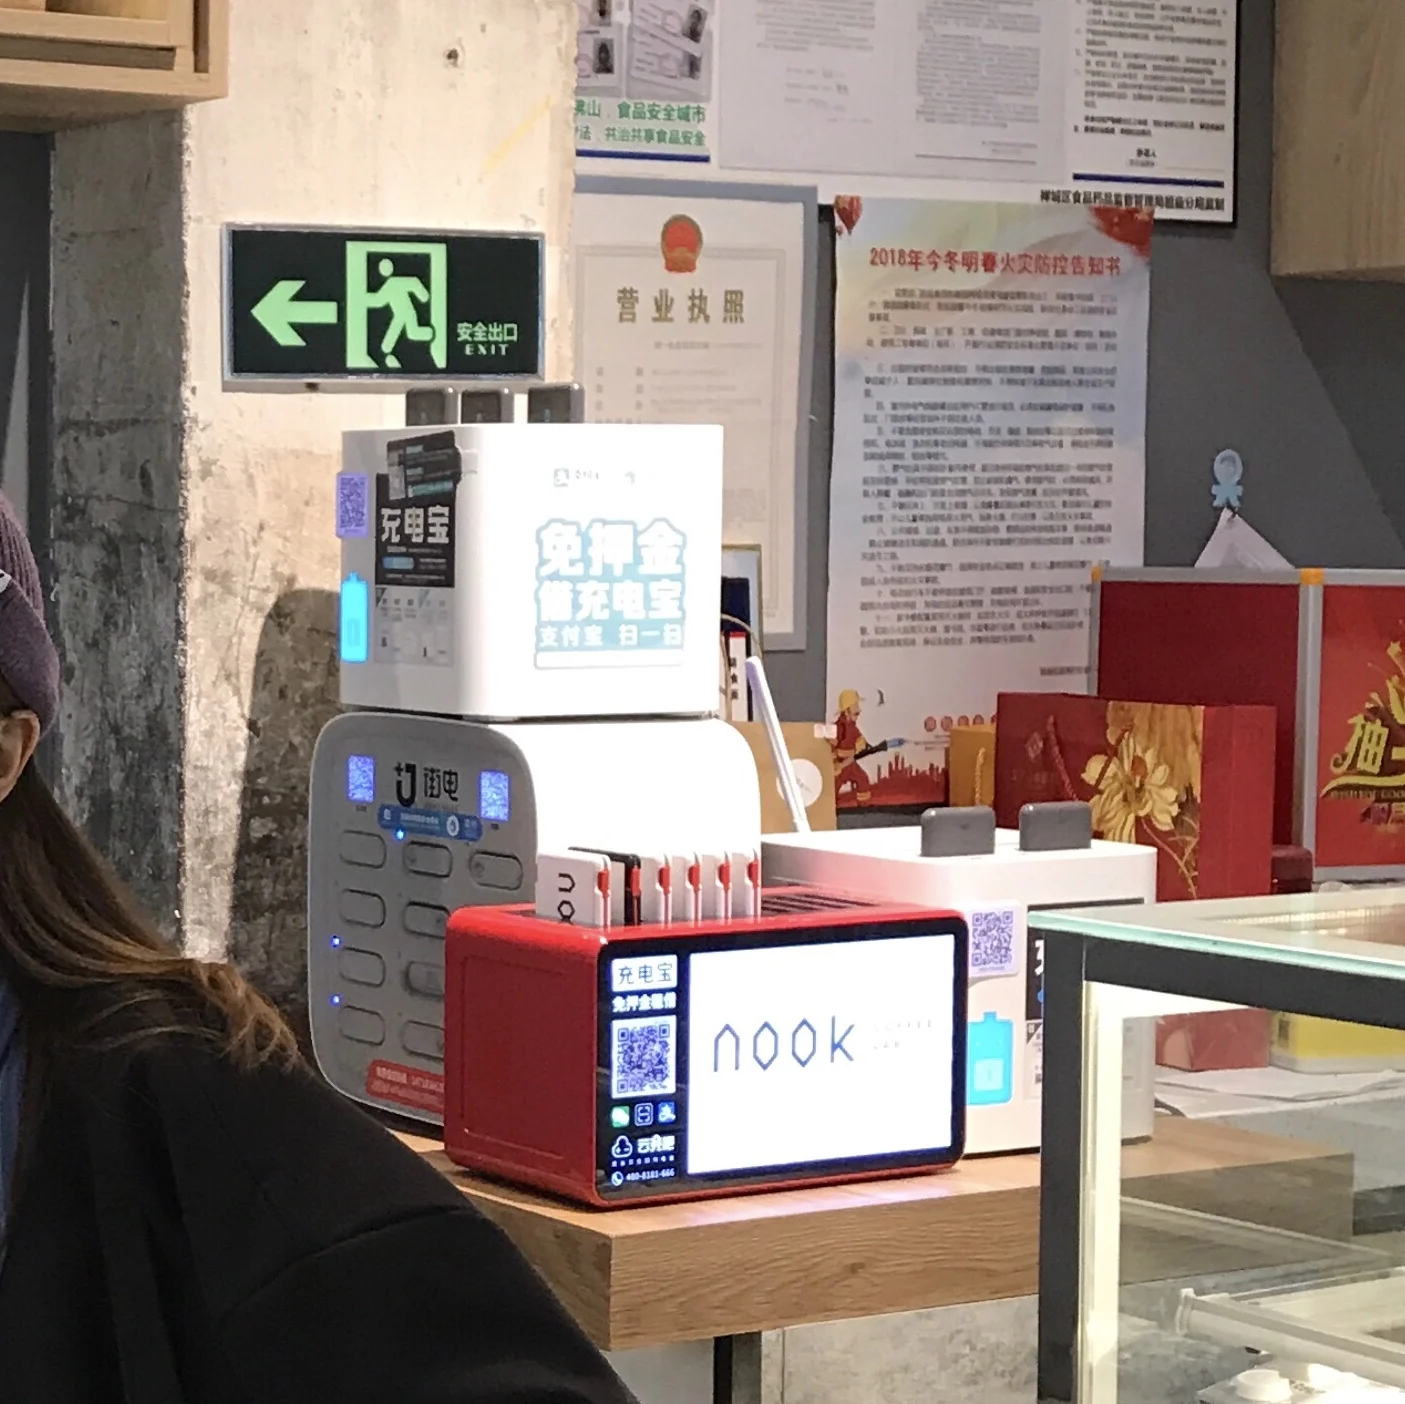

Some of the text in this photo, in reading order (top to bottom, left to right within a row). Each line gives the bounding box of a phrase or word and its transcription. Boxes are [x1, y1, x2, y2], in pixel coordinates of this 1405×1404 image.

[868, 247, 1122, 277] 2018年今冬明春火灾防控告知书
[617, 286, 745, 324] 营业执照
[457, 321, 518, 342] 安全出口
[465, 344, 509, 356] EXIT
[380, 504, 450, 544] 充电宝
[539, 520, 684, 578] 免押金
[618, 962, 673, 985] 充电宝
